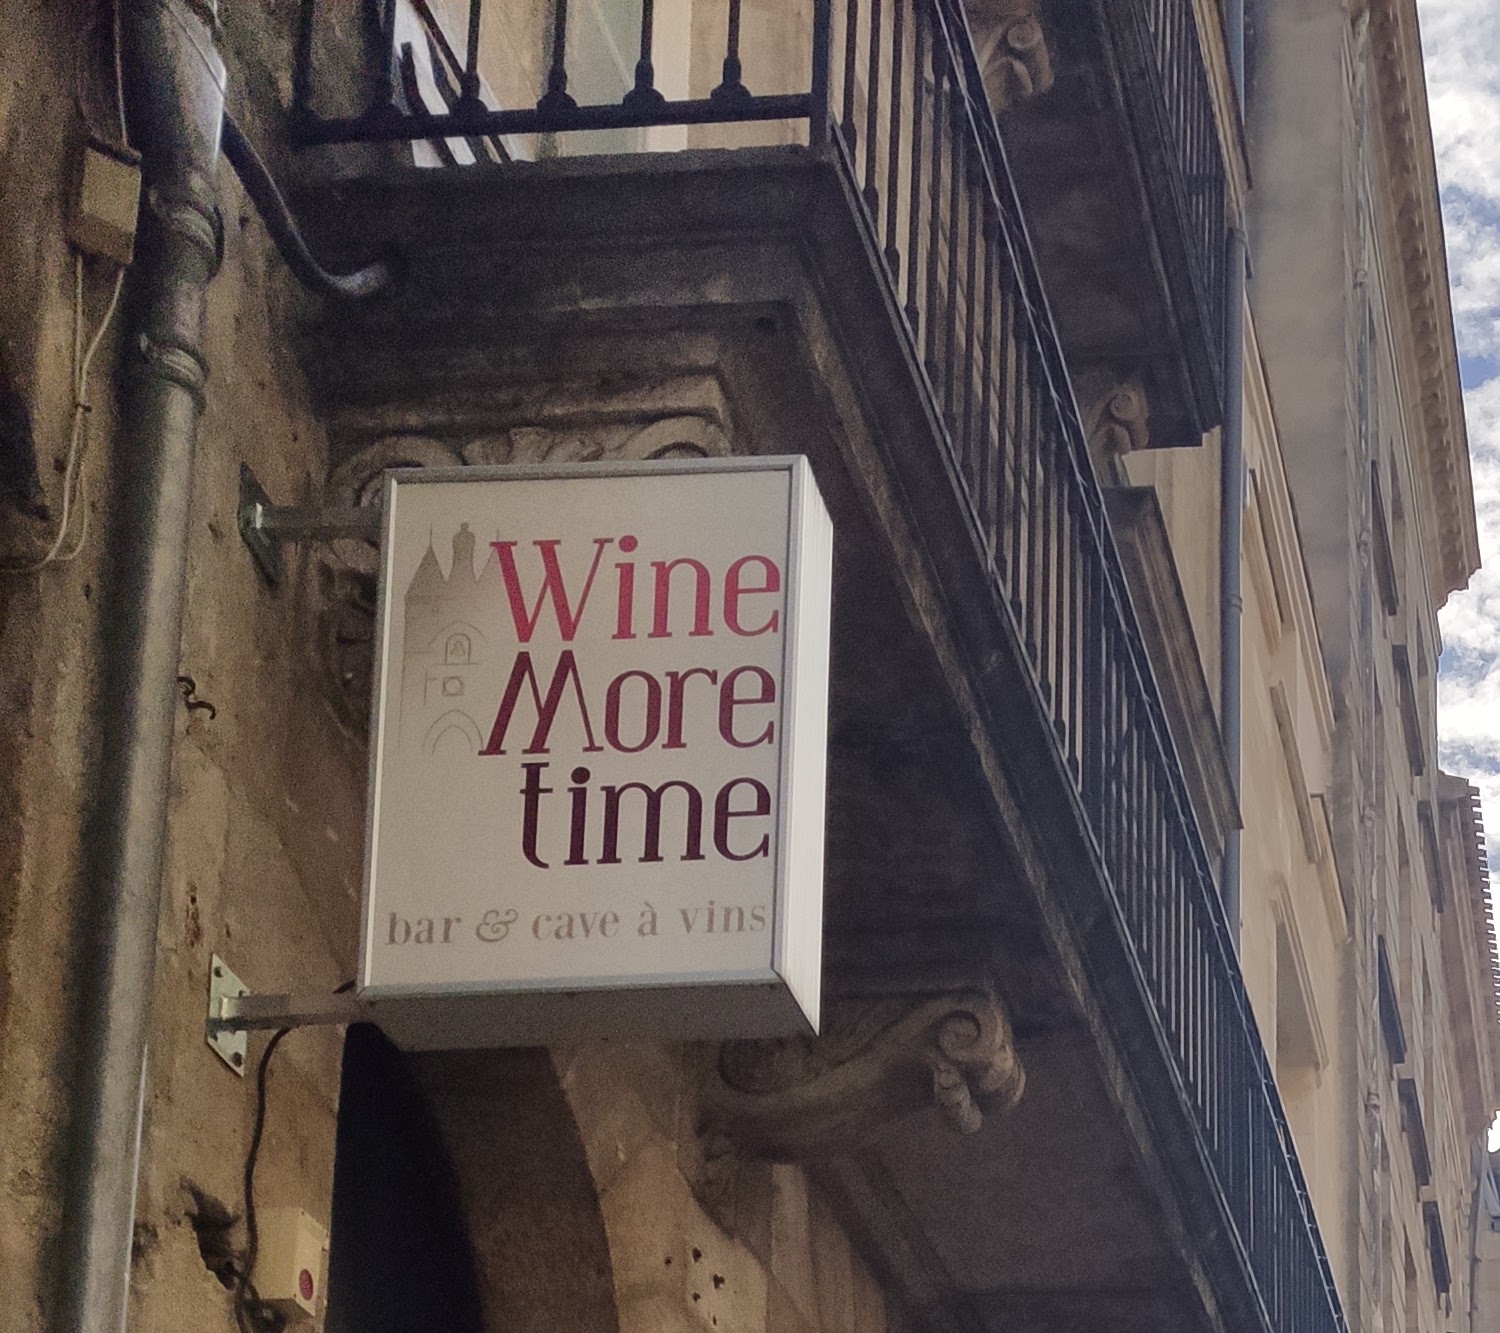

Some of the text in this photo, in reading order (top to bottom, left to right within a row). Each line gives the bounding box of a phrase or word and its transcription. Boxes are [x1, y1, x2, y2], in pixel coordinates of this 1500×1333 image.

[489, 534, 781, 643] Wine
[478, 649, 776, 756] More
[519, 761, 772, 869] time
[385, 900, 767, 945] bar & cave à vins
